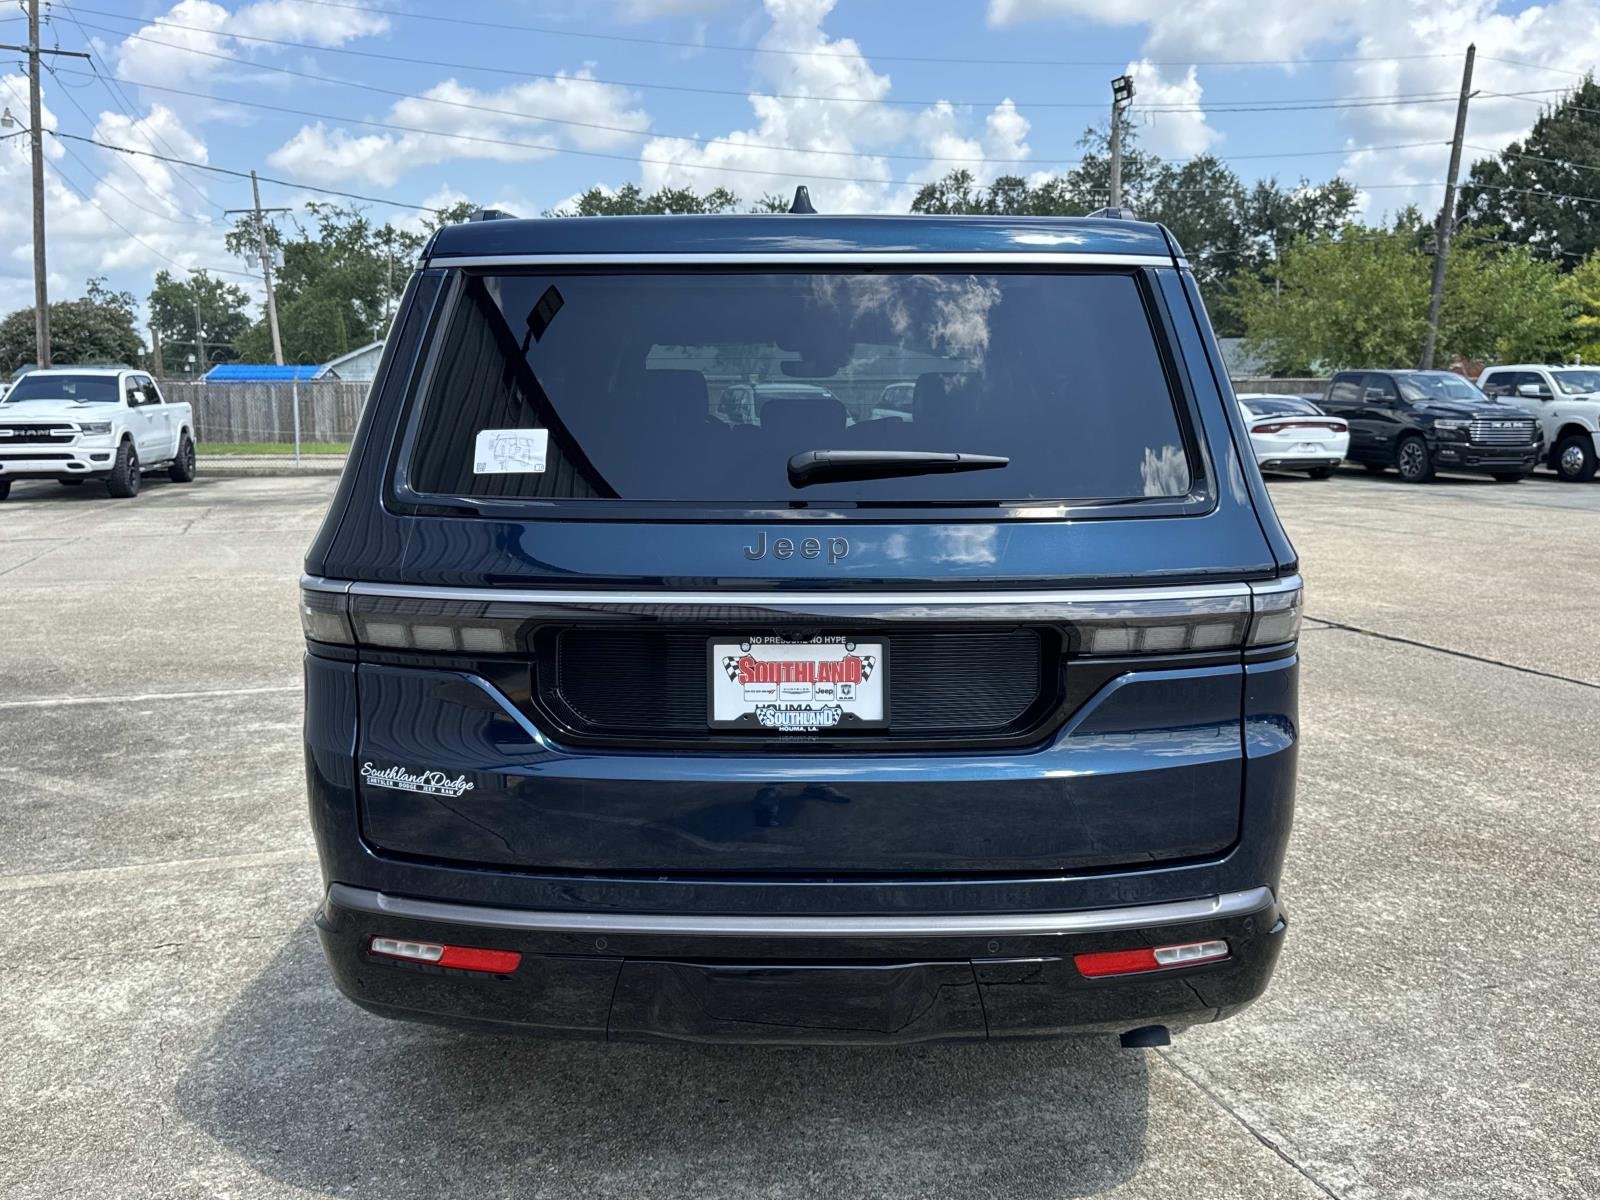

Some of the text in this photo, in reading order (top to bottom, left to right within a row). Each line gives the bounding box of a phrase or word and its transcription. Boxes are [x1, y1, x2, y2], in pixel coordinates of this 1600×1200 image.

[743, 531, 850, 565] Jeep
[750, 636, 762, 644] NO
[810, 636, 823, 644] NO
[825, 636, 847, 644] HYPE
[738, 655, 863, 686] SOUTHLAND
[765, 708, 834, 726] SOUTHLAND
[361, 761, 475, 796] Southland Dodge
[367, 777, 393, 787] CHRYSLER
[398, 782, 417, 790] DODGE
